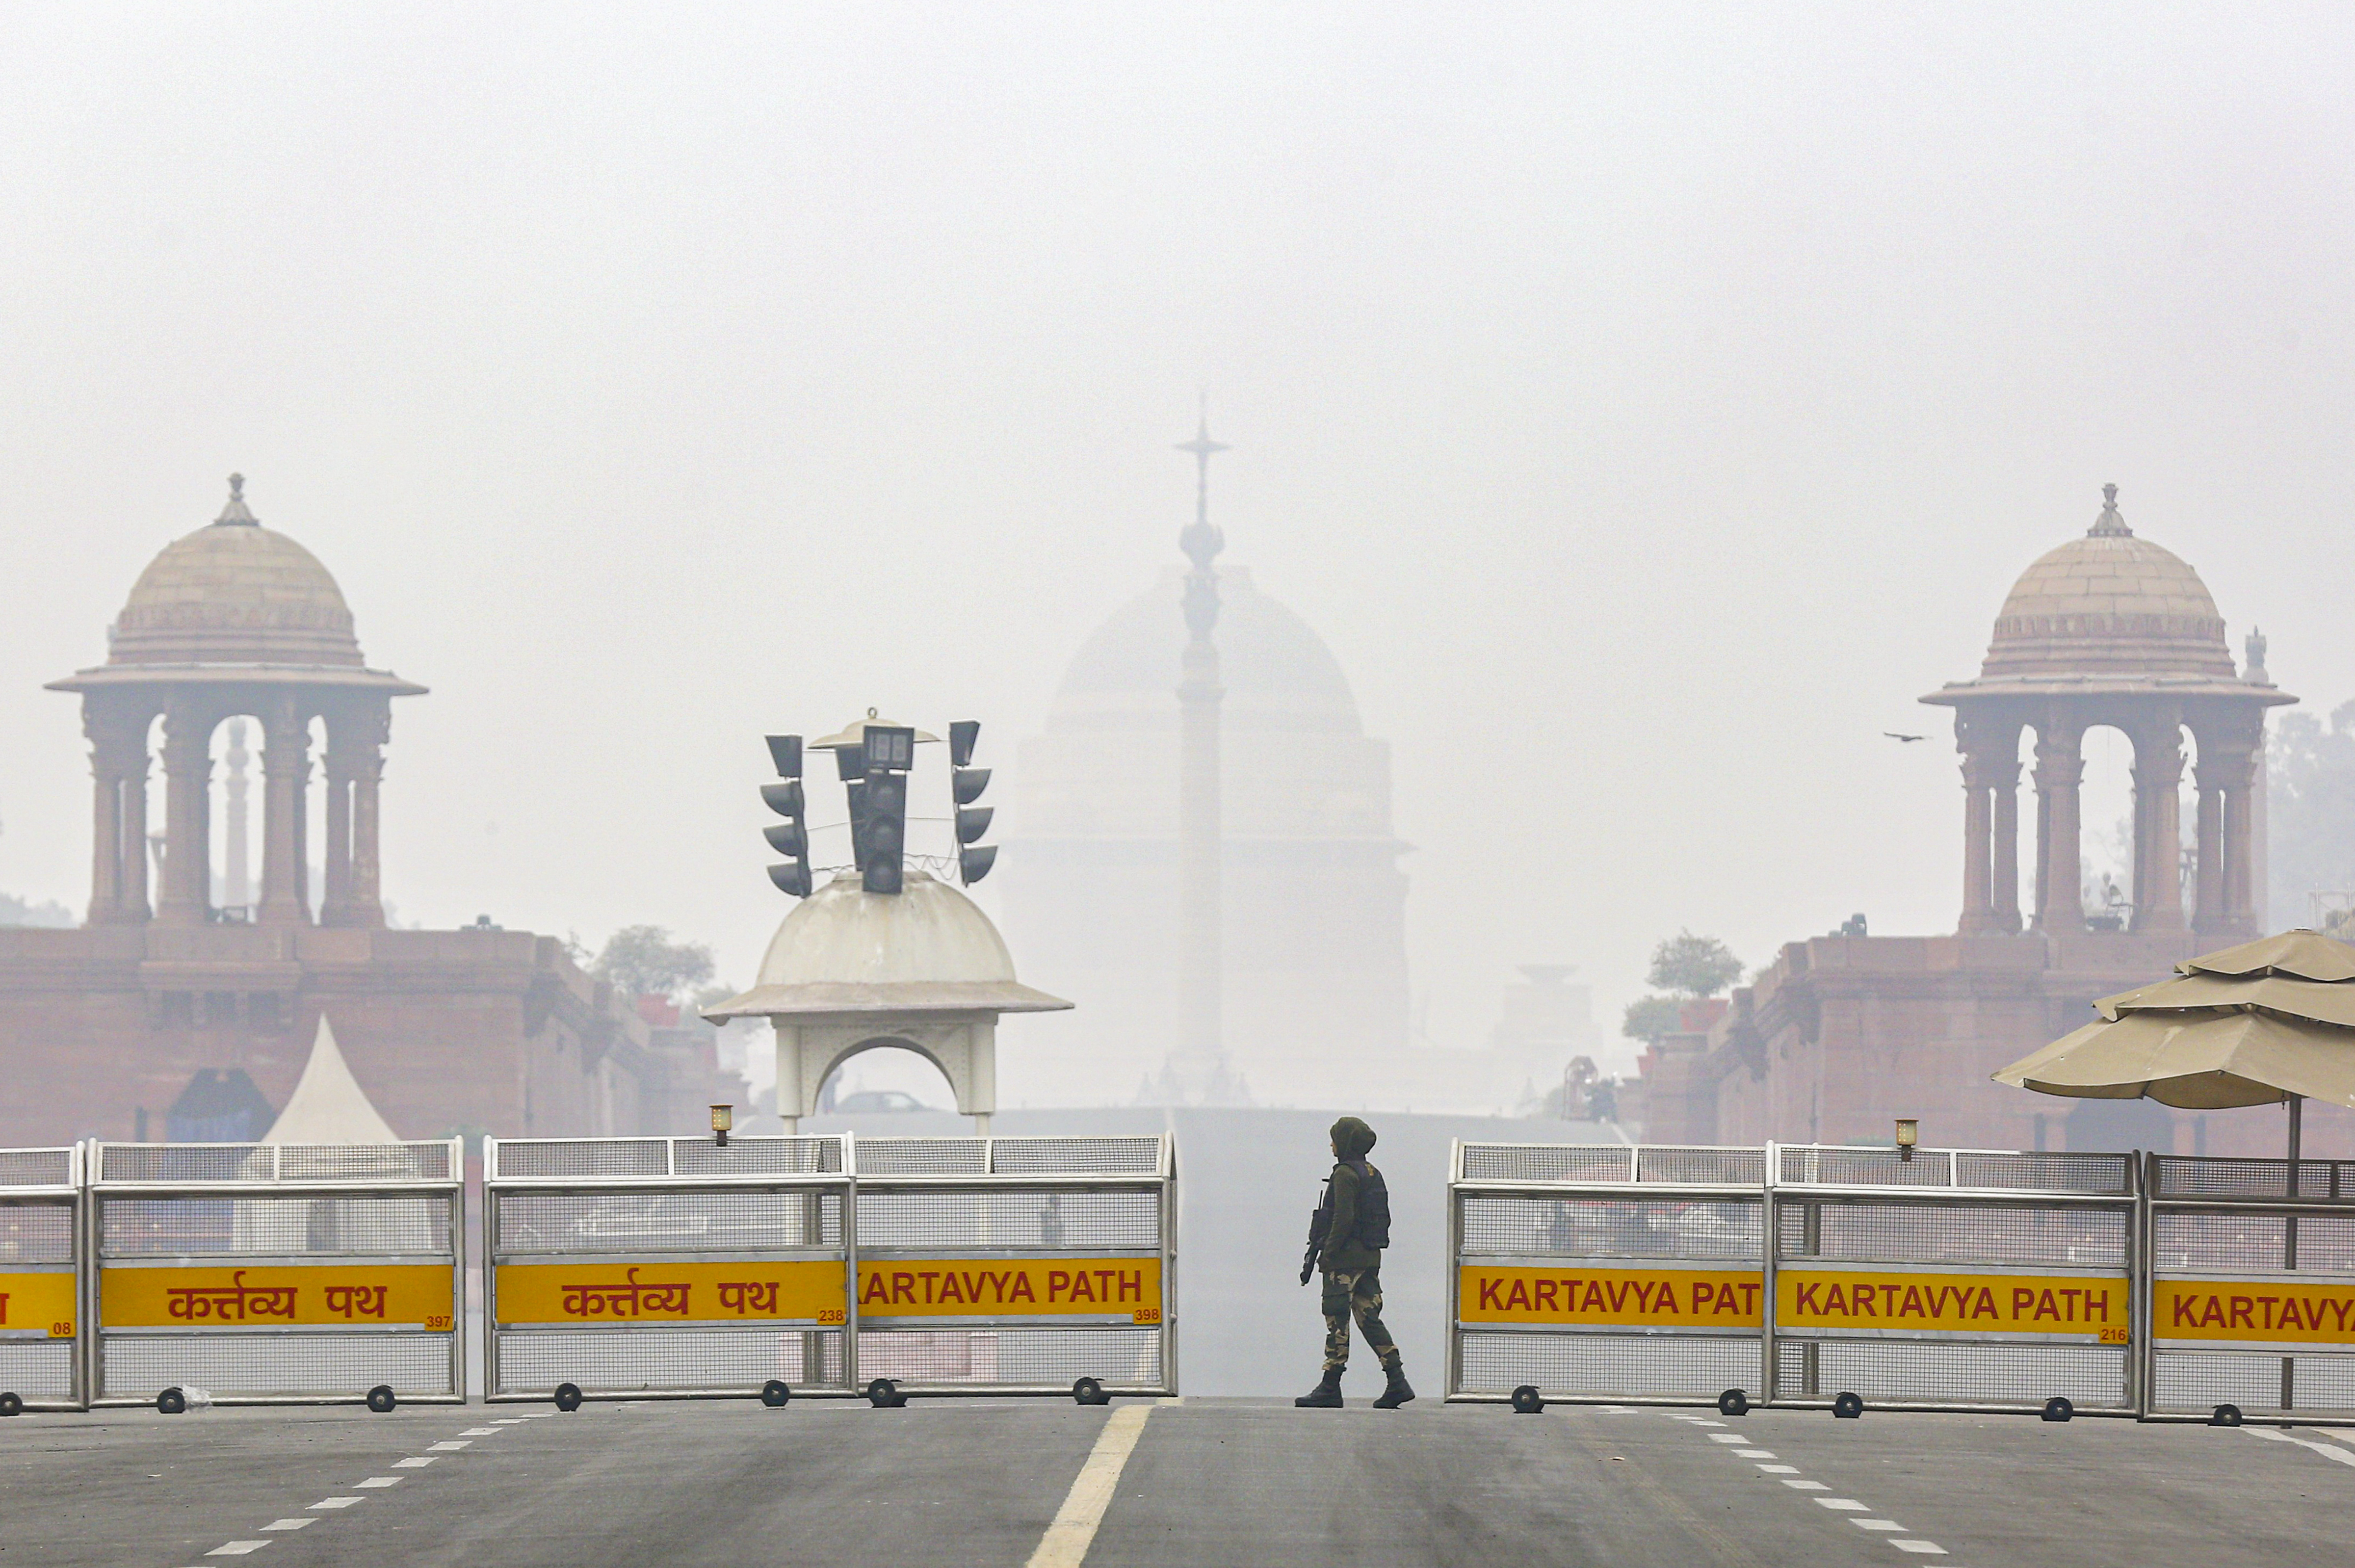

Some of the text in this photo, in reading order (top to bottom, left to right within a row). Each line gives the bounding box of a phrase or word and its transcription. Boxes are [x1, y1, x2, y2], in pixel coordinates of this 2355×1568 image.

[324, 1285, 388, 1318] पथ
[717, 1282, 780, 1314] पथ
[1048, 1270, 1141, 1303] PATH
[1479, 1278, 1761, 1315] KARTAVYA PAT
[1796, 1283, 2108, 1322] KARTAVYA PATH
[53, 1322, 71, 1334] 08
[426, 1316, 451, 1327] 397
[819, 1309, 843, 1321] 238
[1135, 1308, 1159, 1320] 398
[2173, 1295, 2355, 1332] KARTAVY
[2101, 1329, 2126, 1340] 216
